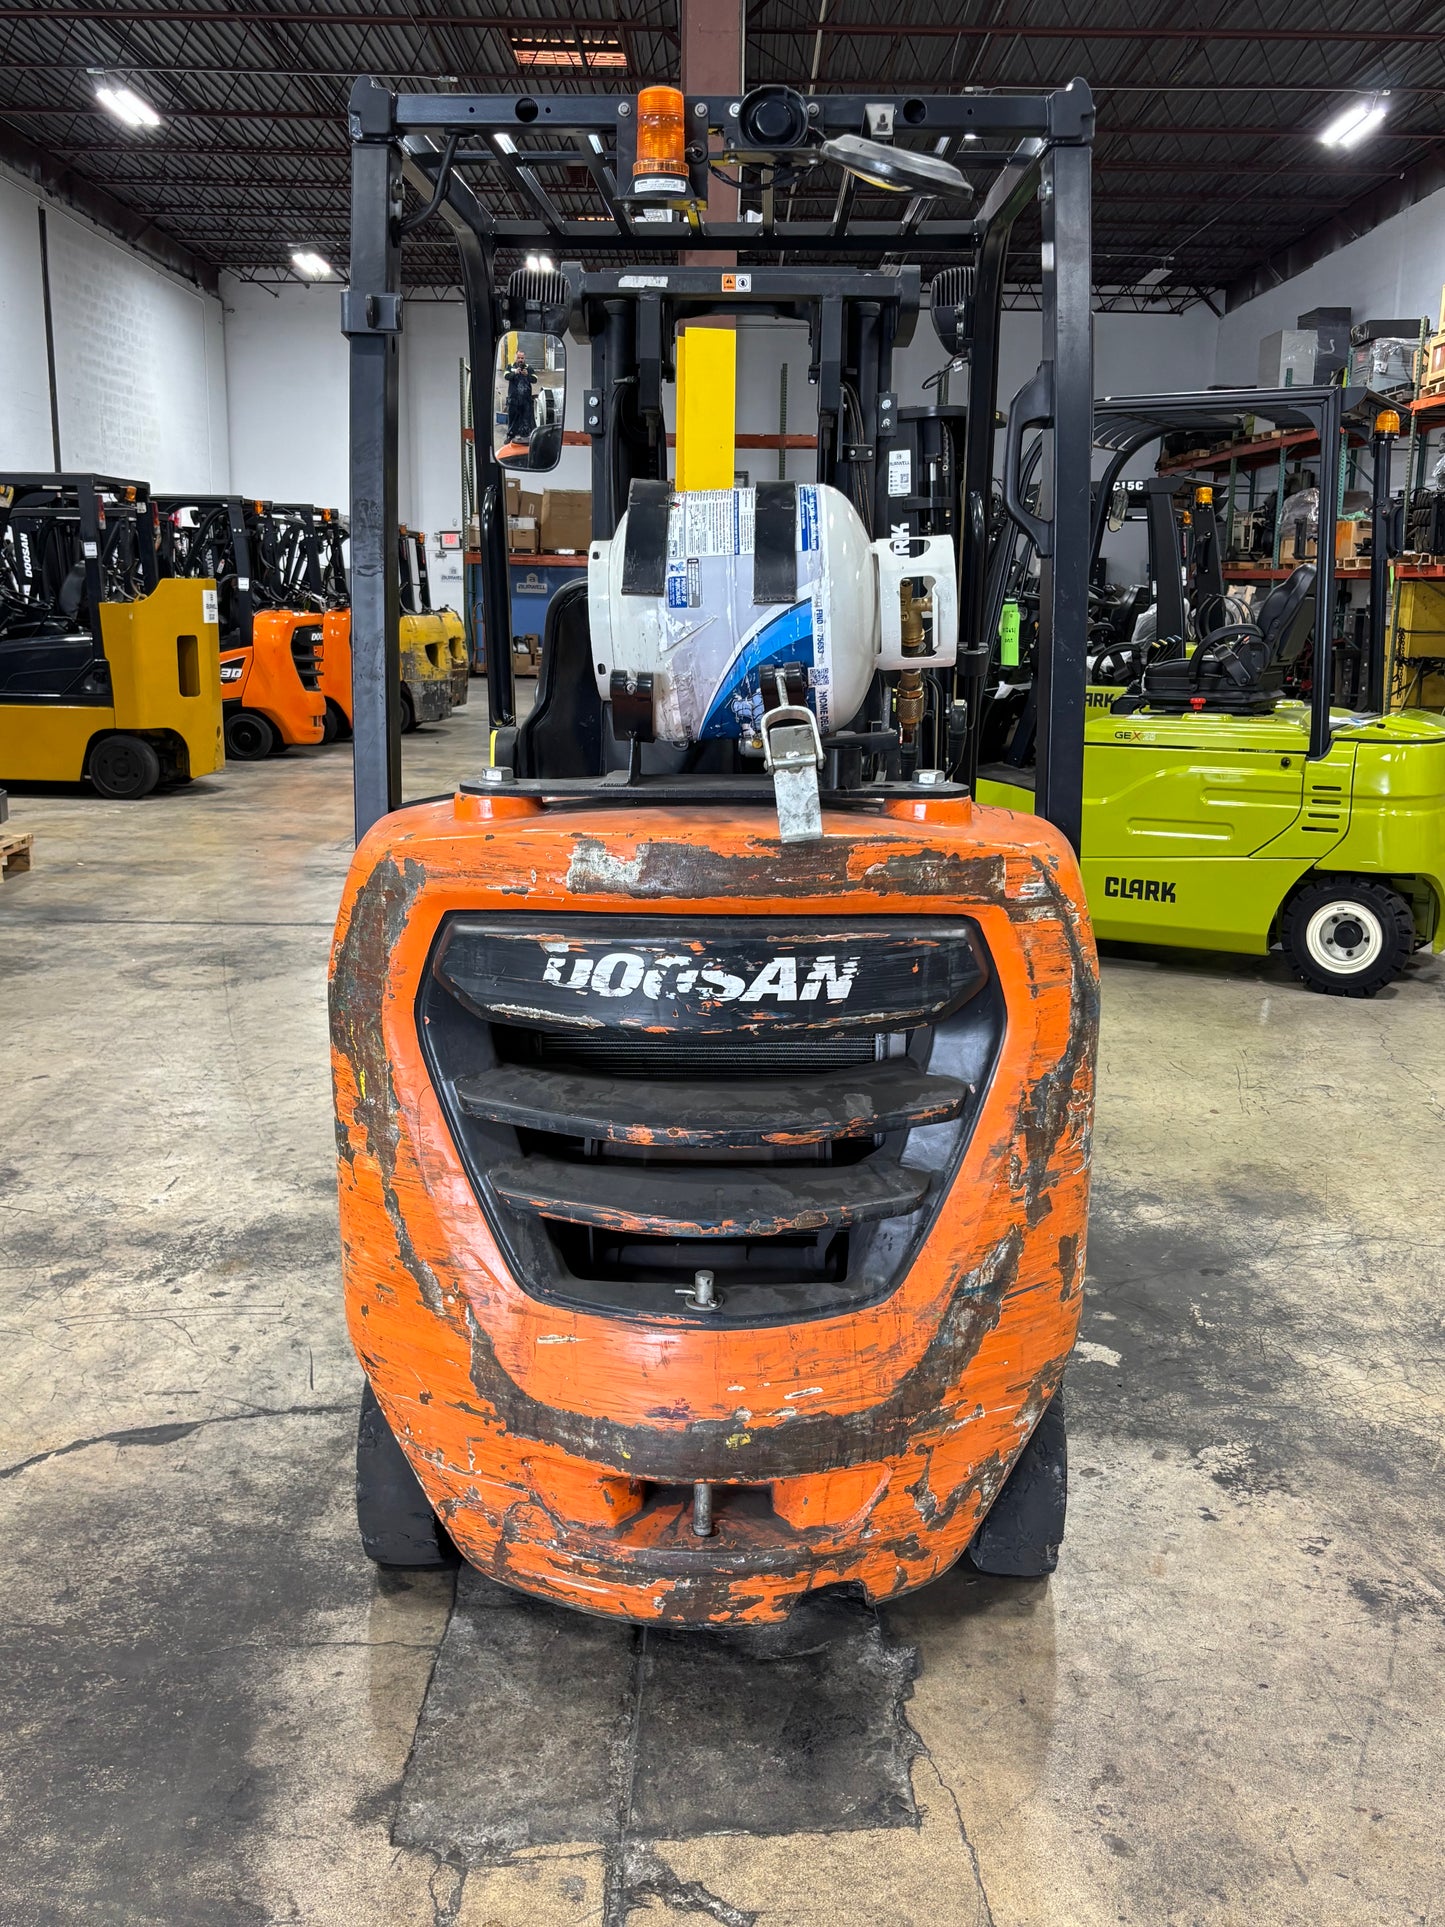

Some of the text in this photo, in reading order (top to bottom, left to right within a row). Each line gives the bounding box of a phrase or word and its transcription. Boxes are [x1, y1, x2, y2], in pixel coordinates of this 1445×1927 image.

[20, 532, 33, 578] DOOSAN
[816, 608, 825, 625] FIND
[817, 690, 829, 715] HOME
[1086, 692, 1115, 708] ARK
[1114, 730, 1141, 742] GEX
[1104, 876, 1177, 904] CLARK
